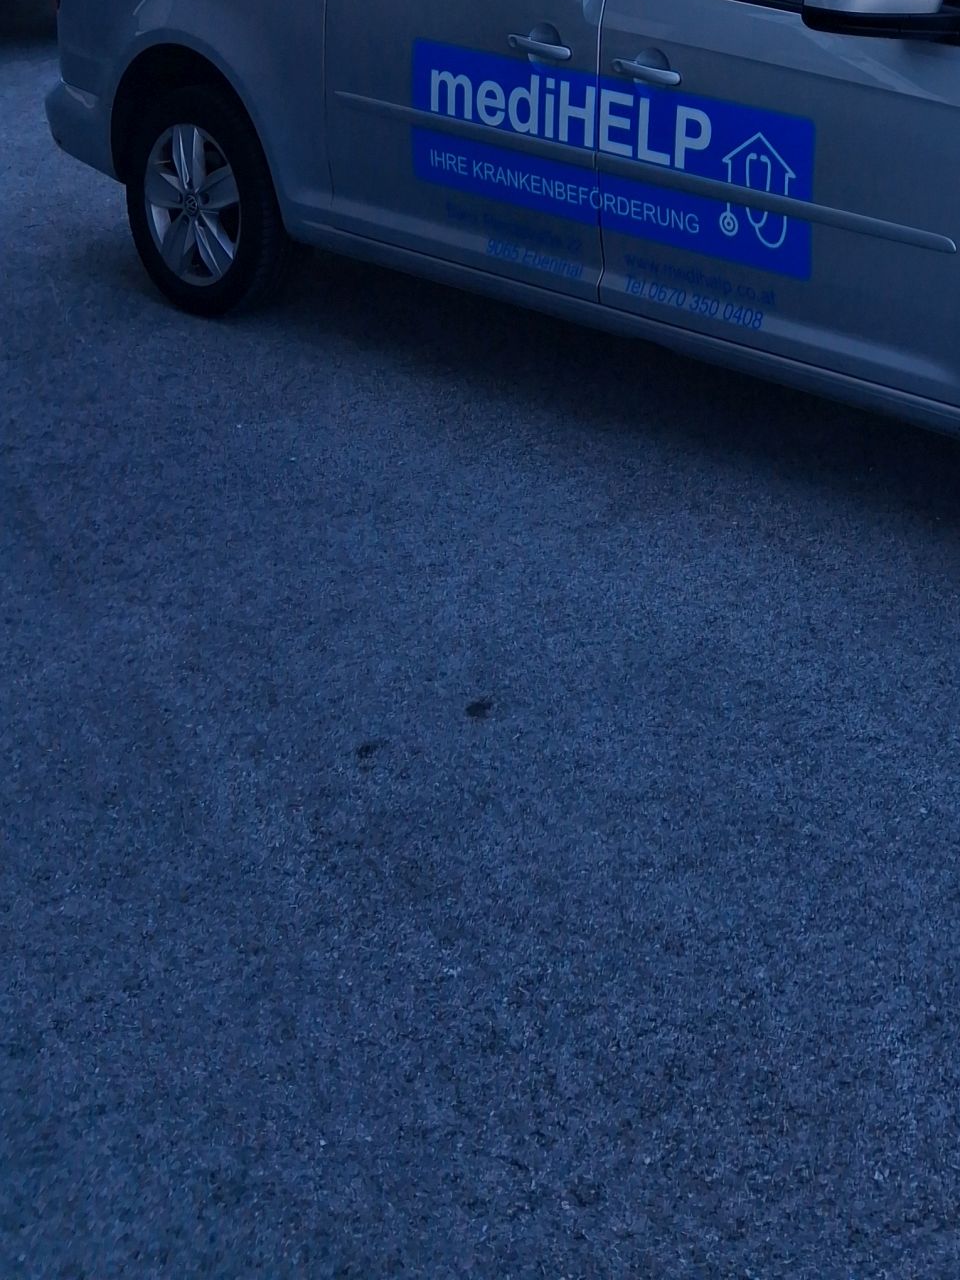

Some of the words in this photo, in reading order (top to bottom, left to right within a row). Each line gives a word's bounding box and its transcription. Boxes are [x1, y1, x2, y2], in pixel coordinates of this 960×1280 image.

[429, 68, 712, 170] mediHELP
[430, 149, 468, 175] IHRE
[472, 160, 700, 234] KRANKENBEFÖRDERUNG
[689, 292, 720, 317] 350
[723, 303, 764, 331] 0408
